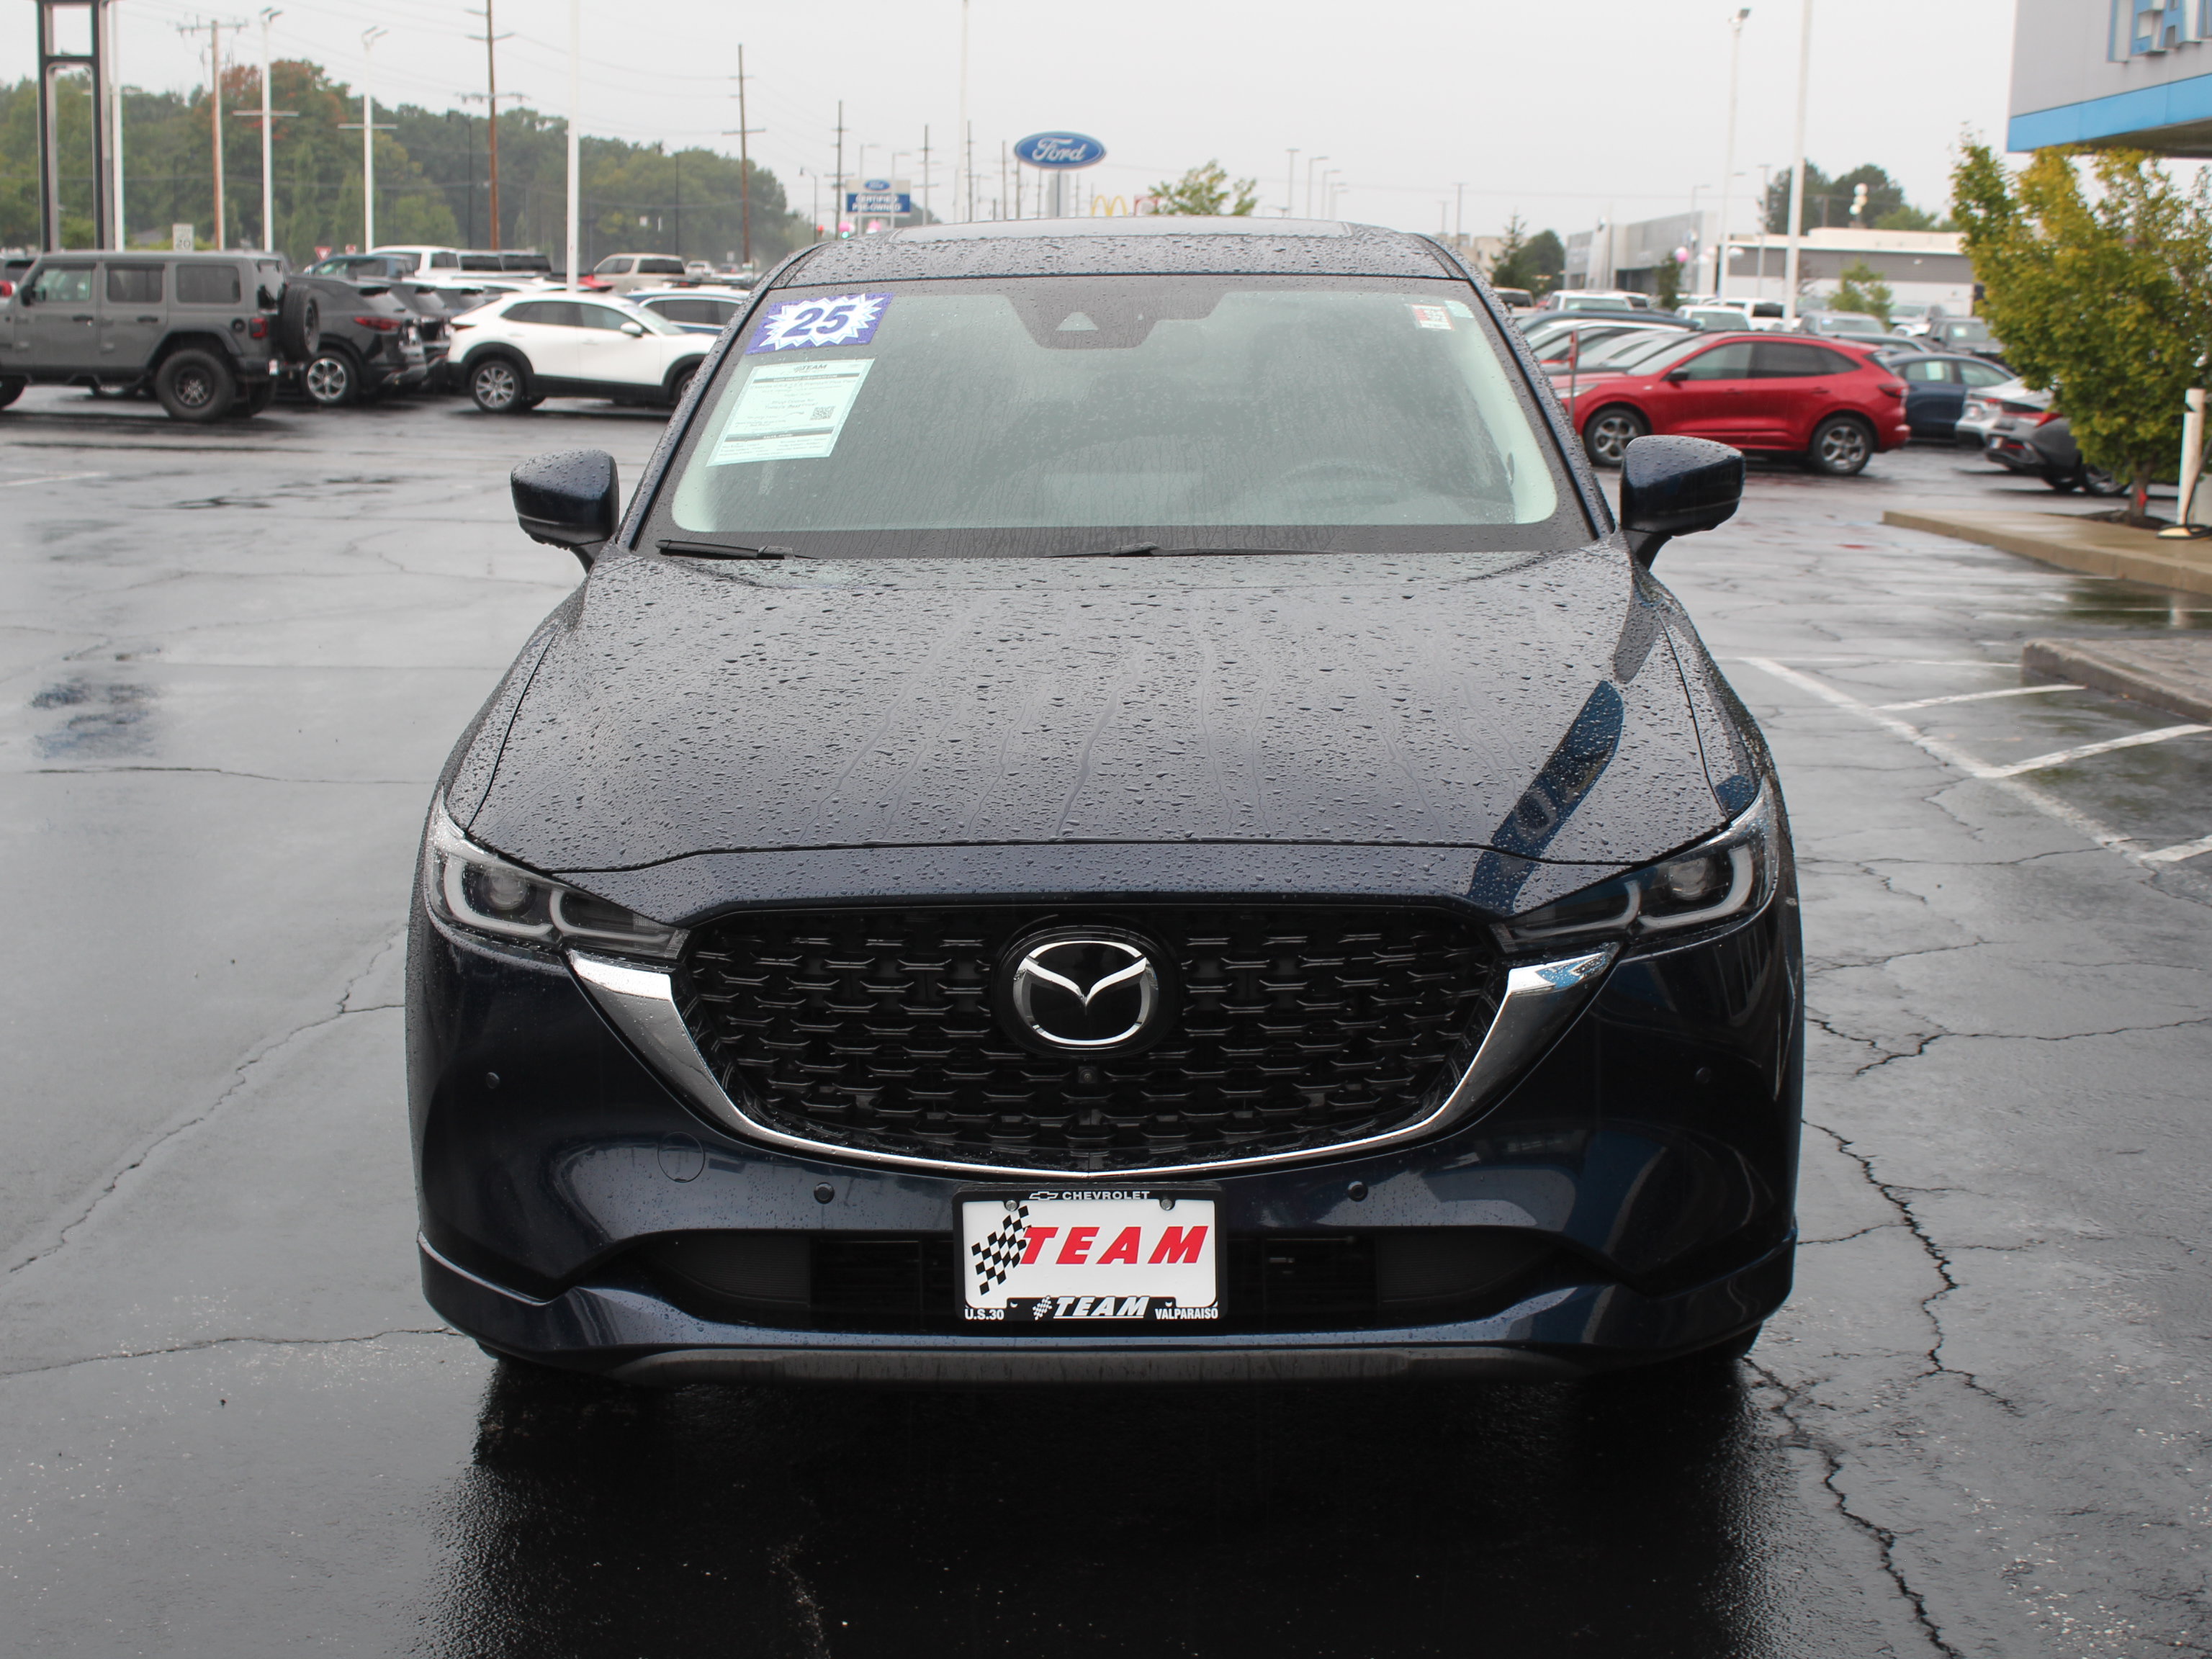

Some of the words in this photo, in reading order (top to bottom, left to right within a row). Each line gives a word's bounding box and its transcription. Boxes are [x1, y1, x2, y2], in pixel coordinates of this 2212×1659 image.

[1032, 137, 1087, 161] Ford
[781, 305, 858, 338] 25
[1062, 1190, 1151, 1200] CHEVROLET
[1020, 1226, 1209, 1265] TEAM
[1053, 1295, 1151, 1318] TEAM
[1154, 1307, 1219, 1320] VALPARAISO
